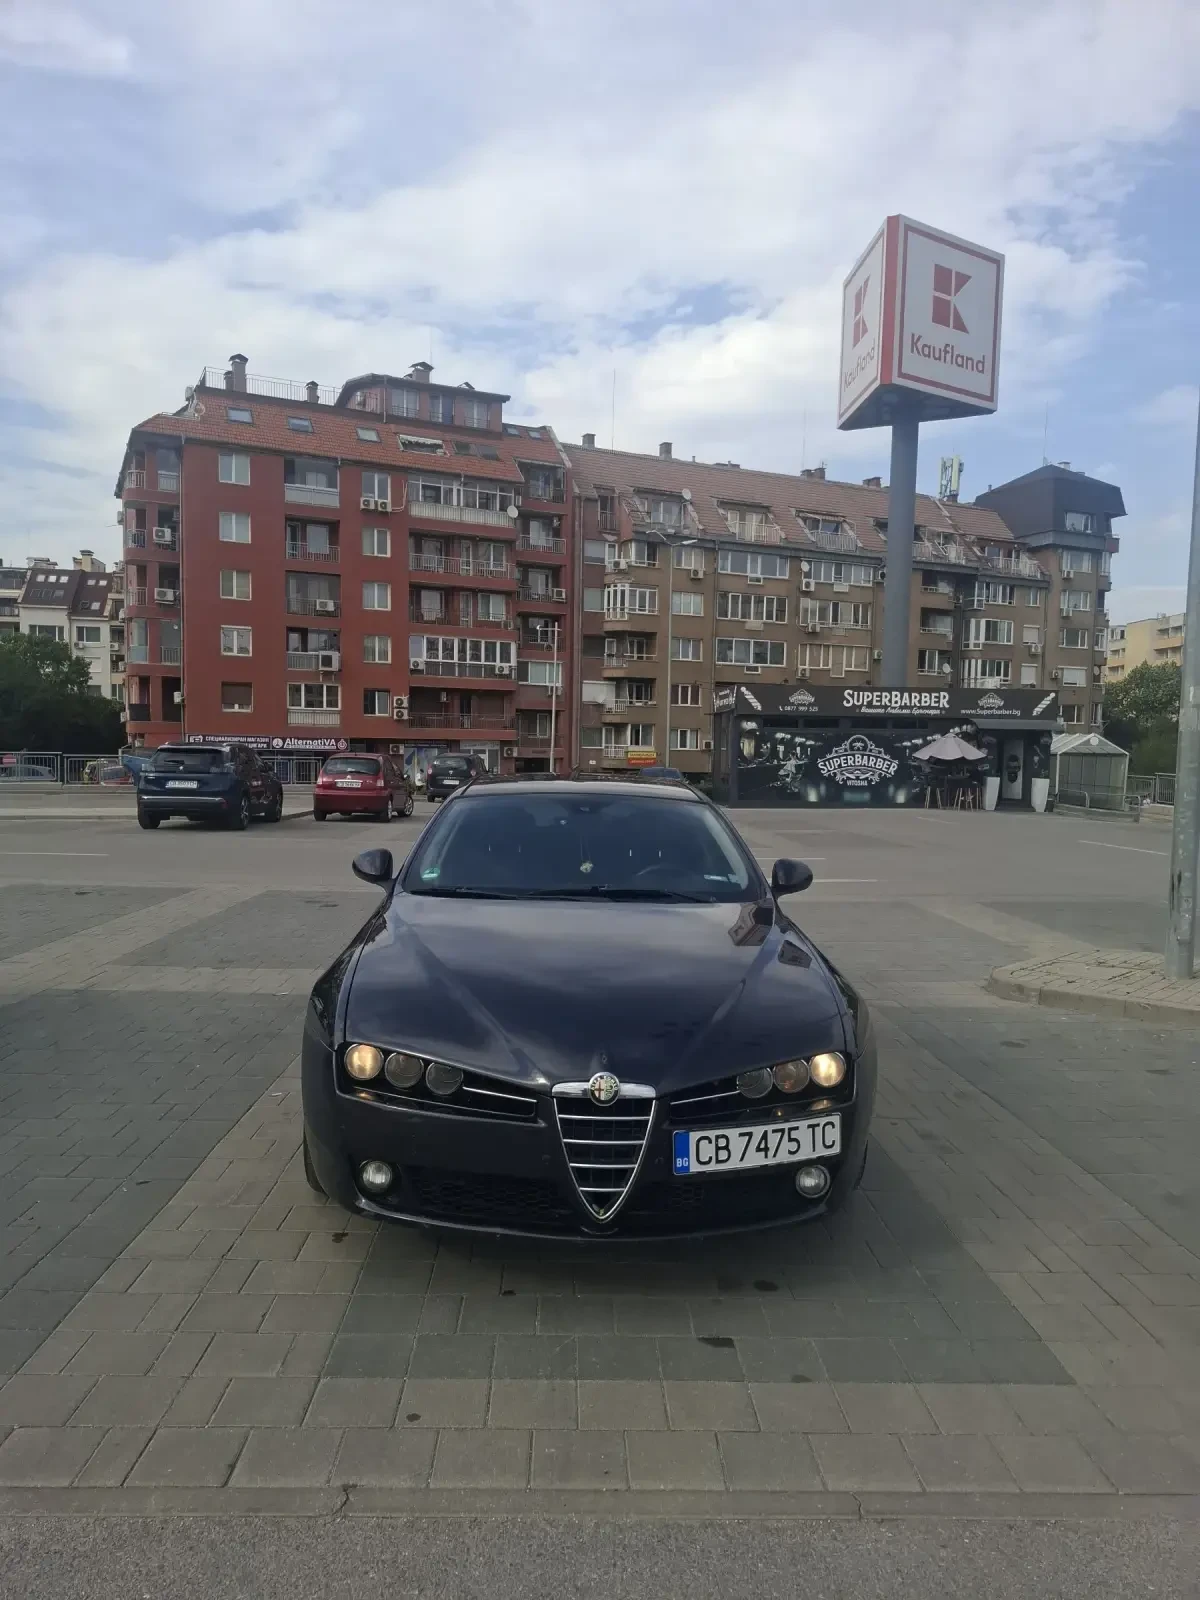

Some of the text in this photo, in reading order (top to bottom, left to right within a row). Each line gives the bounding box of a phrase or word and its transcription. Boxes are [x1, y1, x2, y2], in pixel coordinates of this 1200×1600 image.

[843, 338, 876, 390] Kaufland
[910, 332, 986, 374] Kaufland
[284, 737, 336, 748] AlternatiVA
[818, 754, 898, 775] SUPERBARBER
[695, 1121, 835, 1166] CB 7475 TC
[676, 1157, 689, 1168] BG
